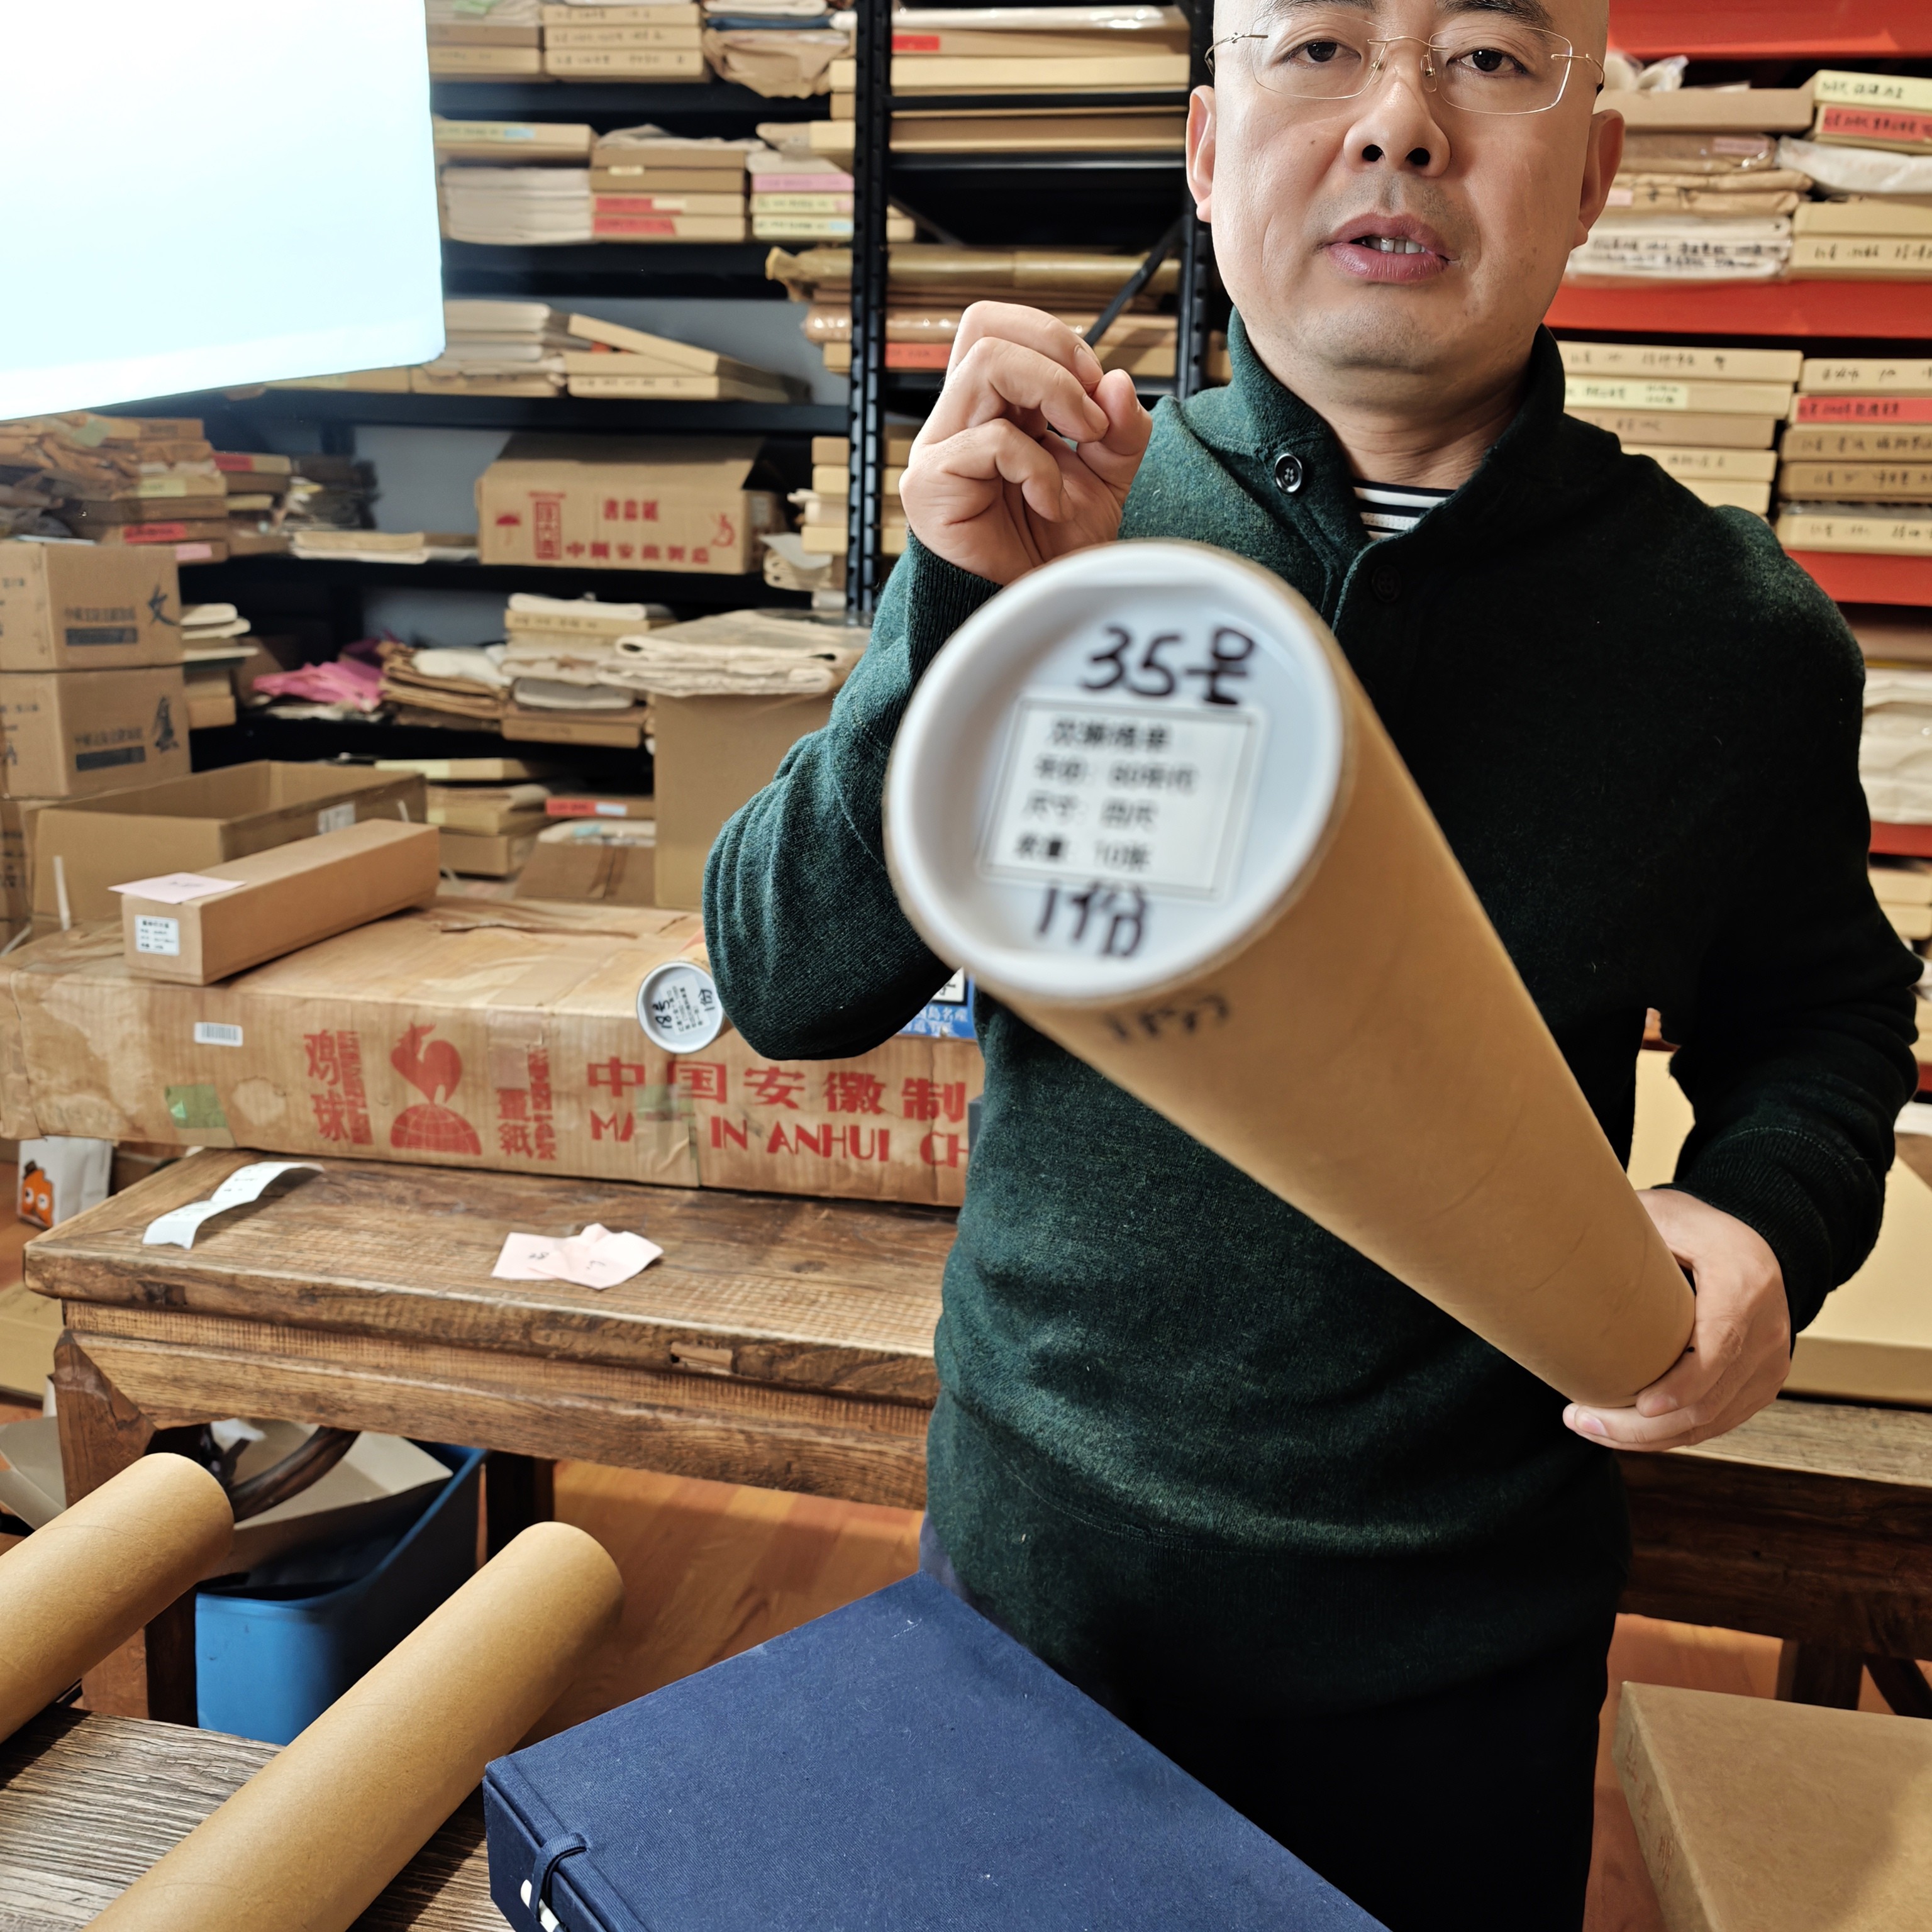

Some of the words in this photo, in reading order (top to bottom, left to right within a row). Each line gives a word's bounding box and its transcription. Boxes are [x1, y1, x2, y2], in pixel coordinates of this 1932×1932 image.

[1080, 624, 1257, 705] 35号
[1038, 879, 1146, 957] 1份
[710, 1116, 748, 1152] IN
[767, 1120, 890, 1162] ANHUI
